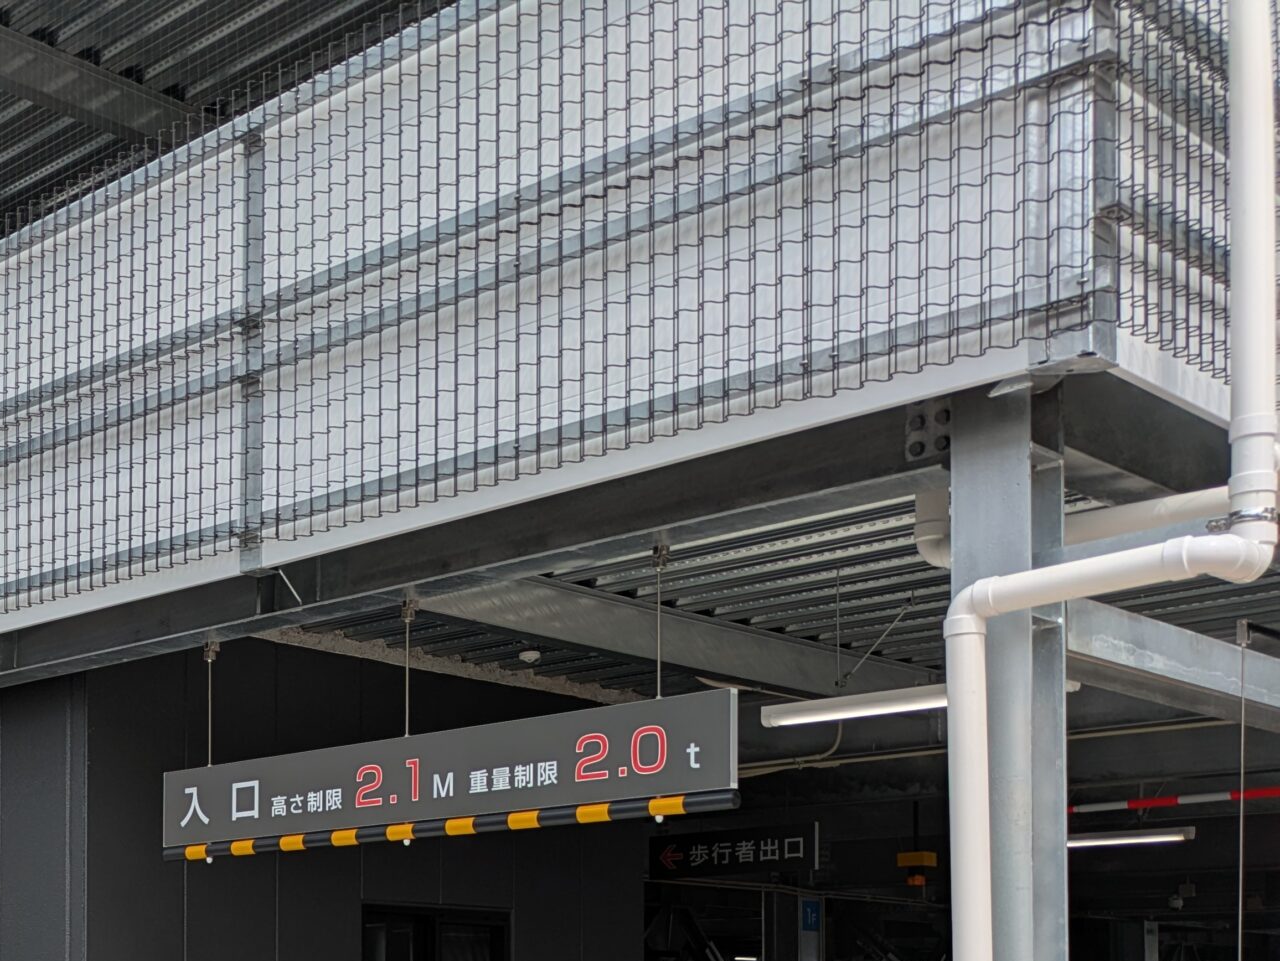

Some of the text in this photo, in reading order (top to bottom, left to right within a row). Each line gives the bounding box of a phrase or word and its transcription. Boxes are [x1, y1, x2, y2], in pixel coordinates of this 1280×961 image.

[271, 788, 343, 818] 高さ制限
[355, 758, 420, 808] 2.1
[432, 772, 454, 799] M
[468, 760, 558, 794] 重量制限
[575, 725, 668, 782] 2.0
[686, 742, 701, 769] t
[689, 837, 804, 867] 歩行者出口
[805, 907, 817, 925] 1F
